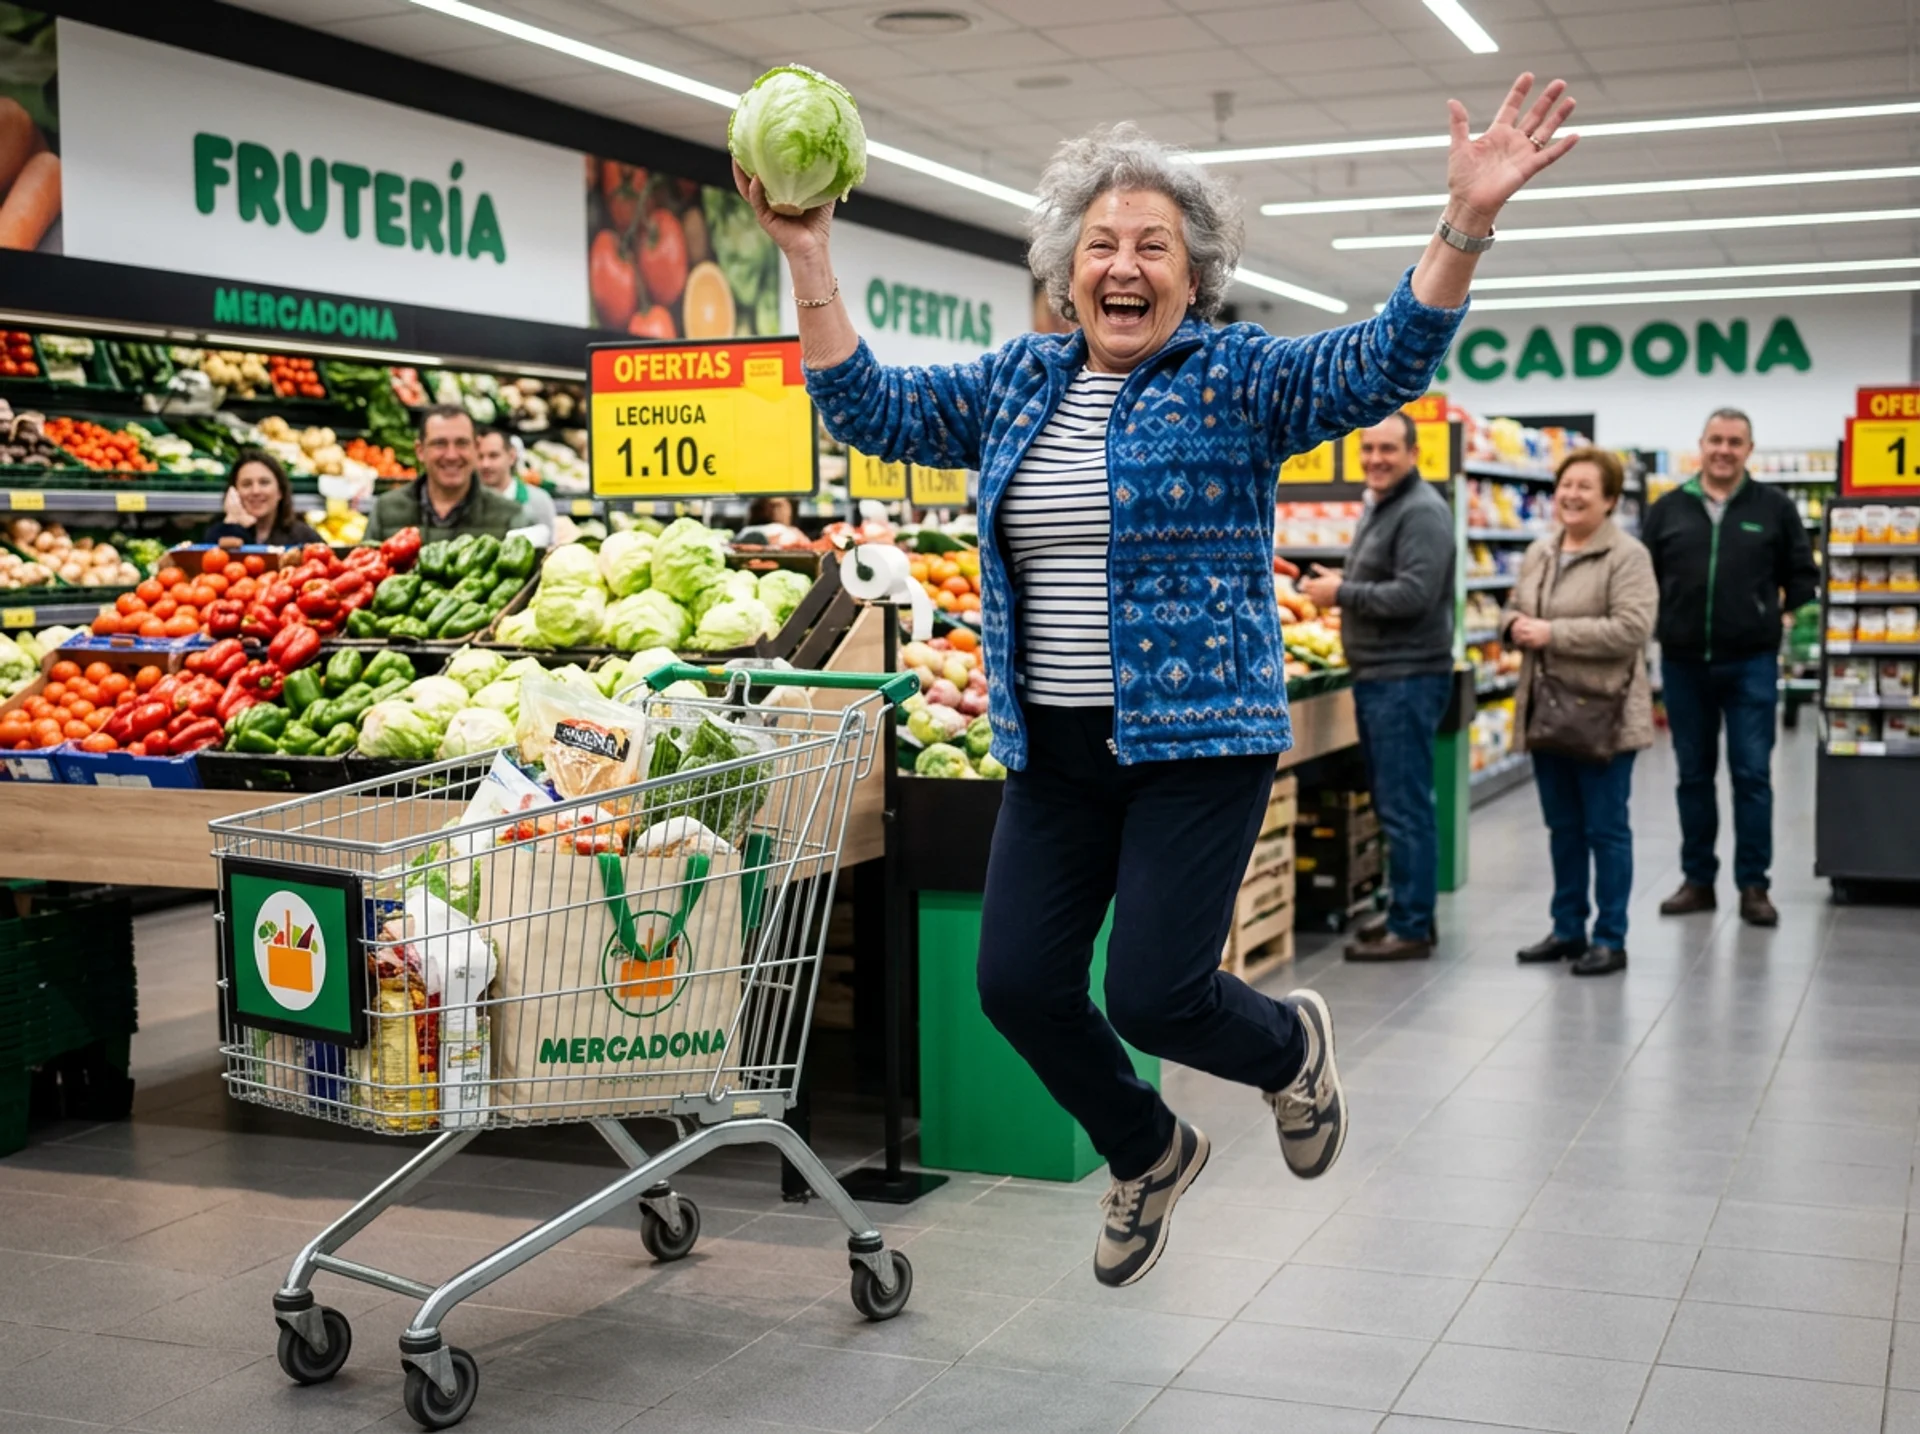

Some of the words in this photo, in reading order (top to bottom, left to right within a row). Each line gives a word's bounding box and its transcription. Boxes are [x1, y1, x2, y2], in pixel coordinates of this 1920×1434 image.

[193, 131, 507, 264] FRUTERÍA
[212, 287, 399, 341] MERCADONA
[866, 277, 992, 347] OFERTAS
[613, 350, 732, 383] OFERTAS
[1436, 315, 1812, 384] CADONA
[616, 405, 707, 426] LECHUGA
[539, 1028, 728, 1064] MERCADONA
